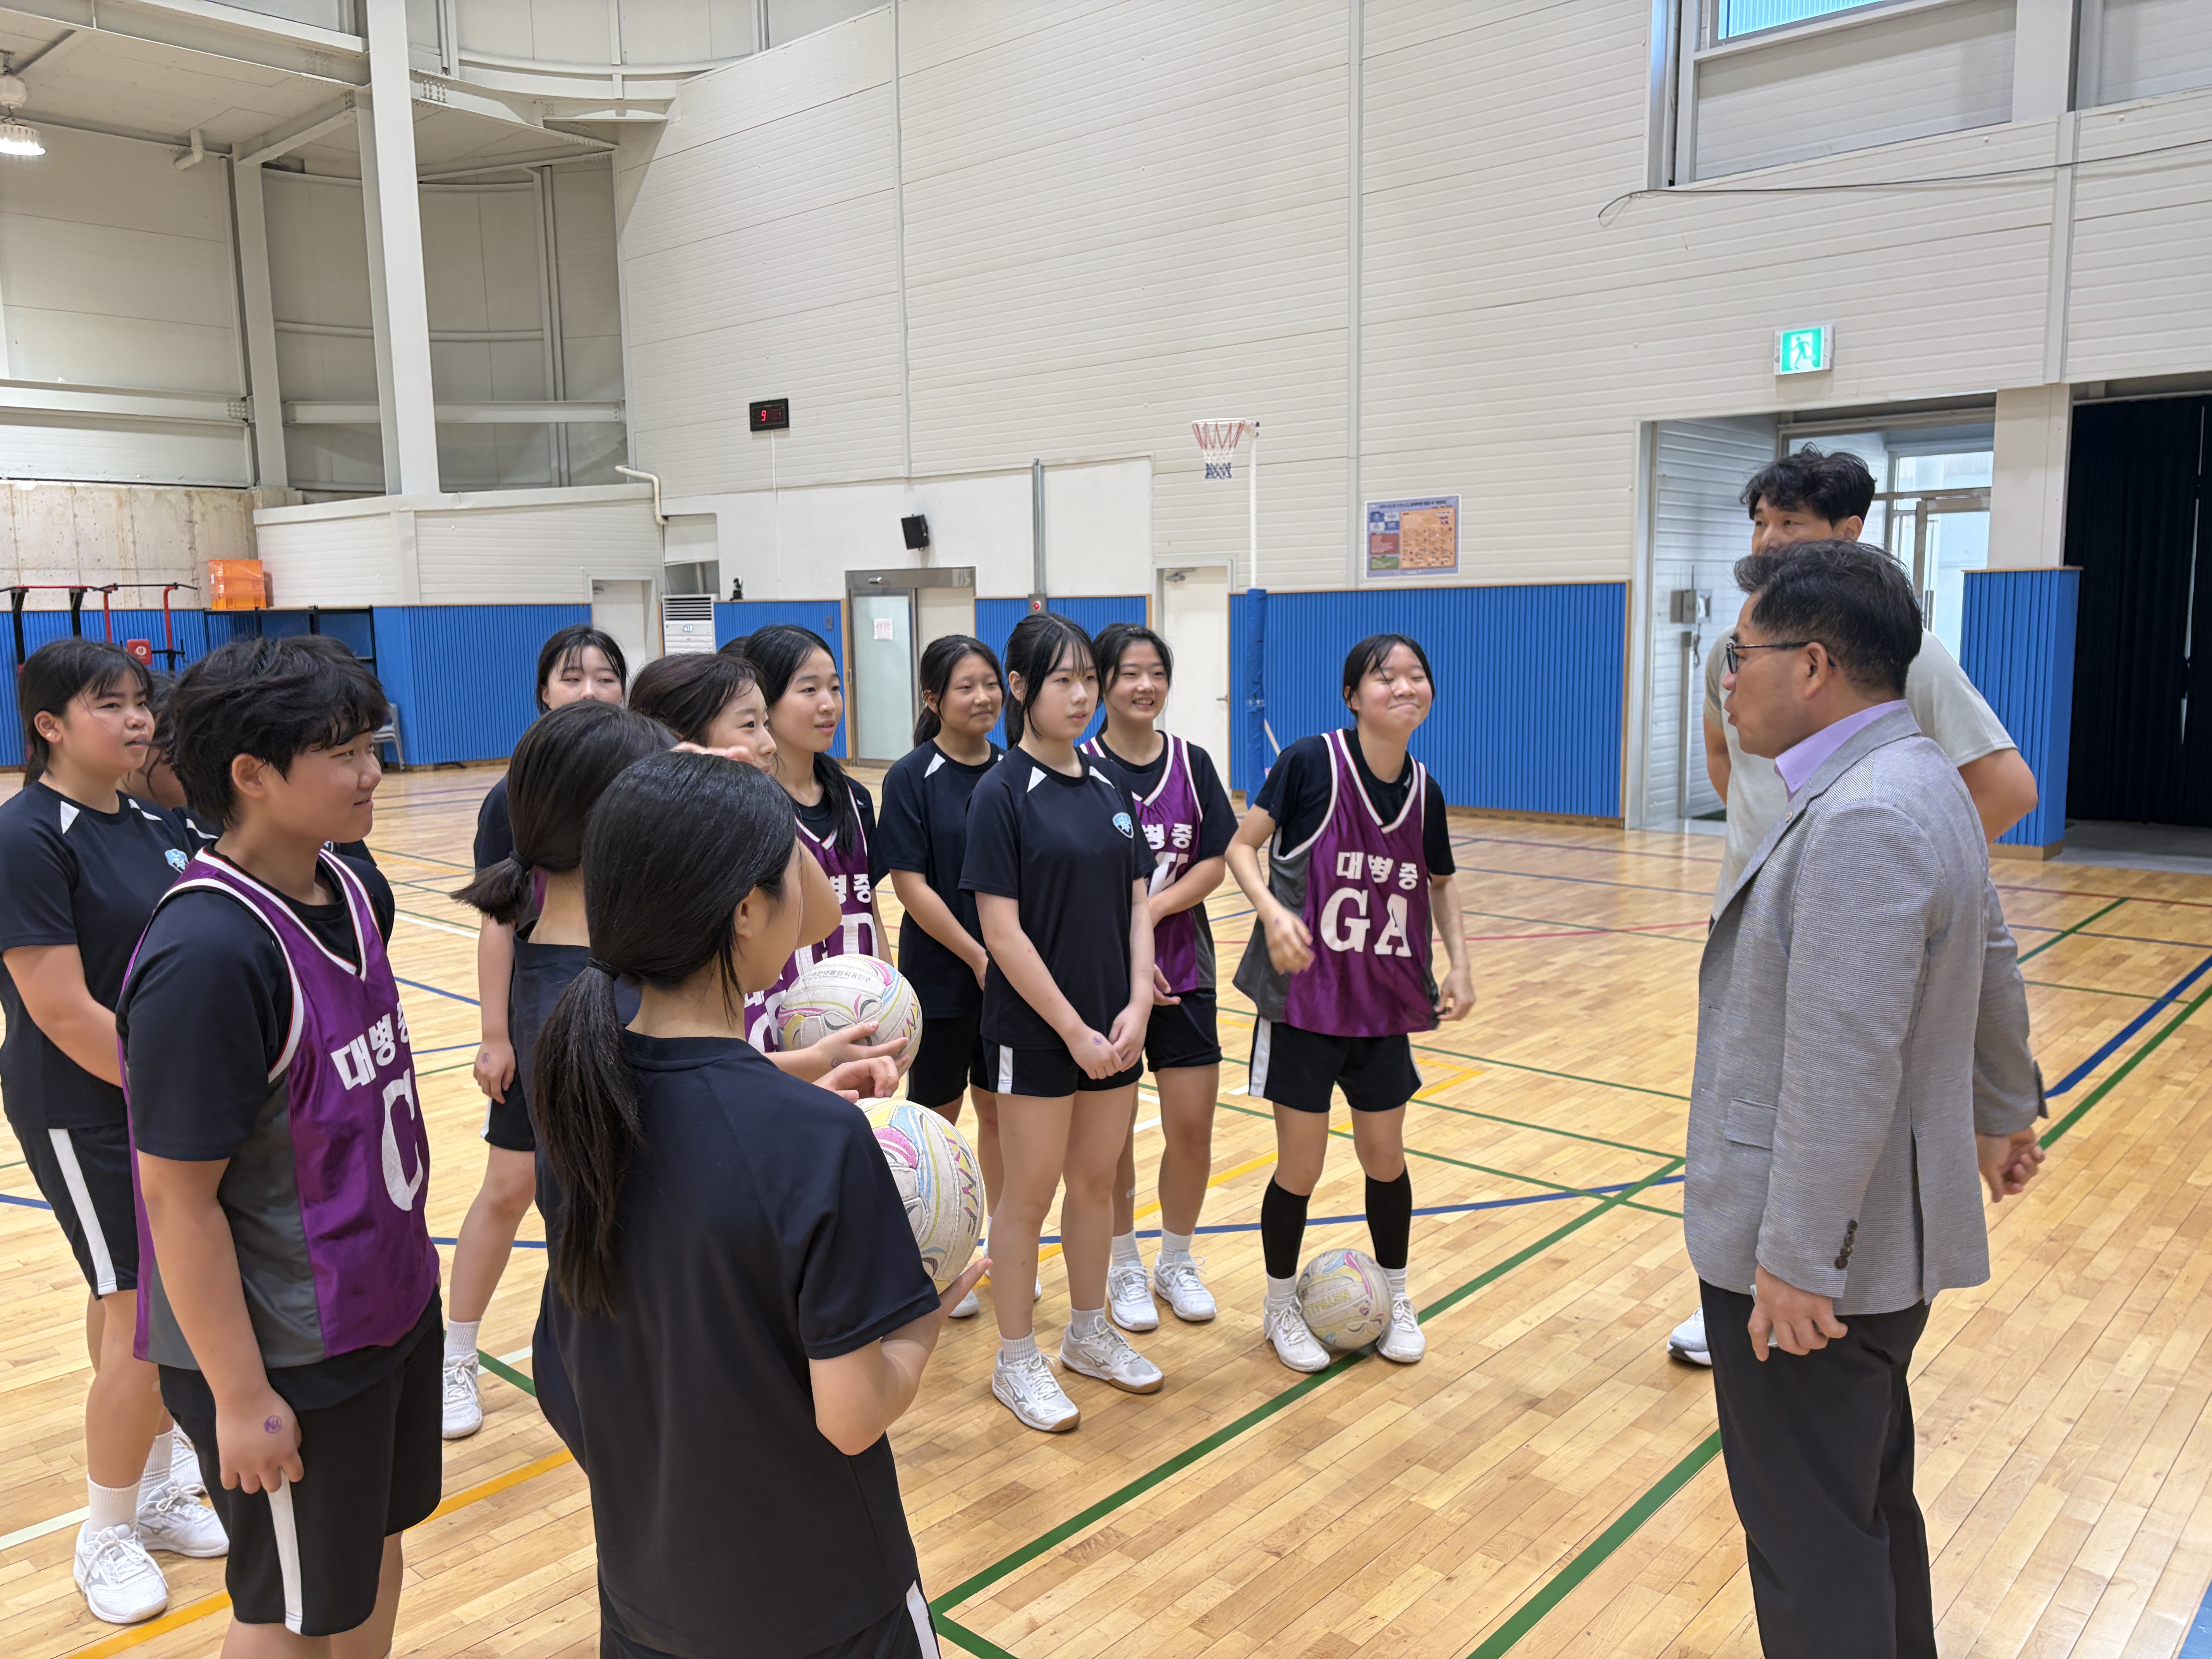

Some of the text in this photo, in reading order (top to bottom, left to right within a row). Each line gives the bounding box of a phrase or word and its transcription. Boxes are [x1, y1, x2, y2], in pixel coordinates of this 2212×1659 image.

[1142, 823, 1192, 849] 병중
[1336, 852, 1418, 890] 대병중
[829, 873, 871, 903] 병중
[1321, 887, 1412, 957] GA
[1305, 1290, 1350, 1316] NETBALL
